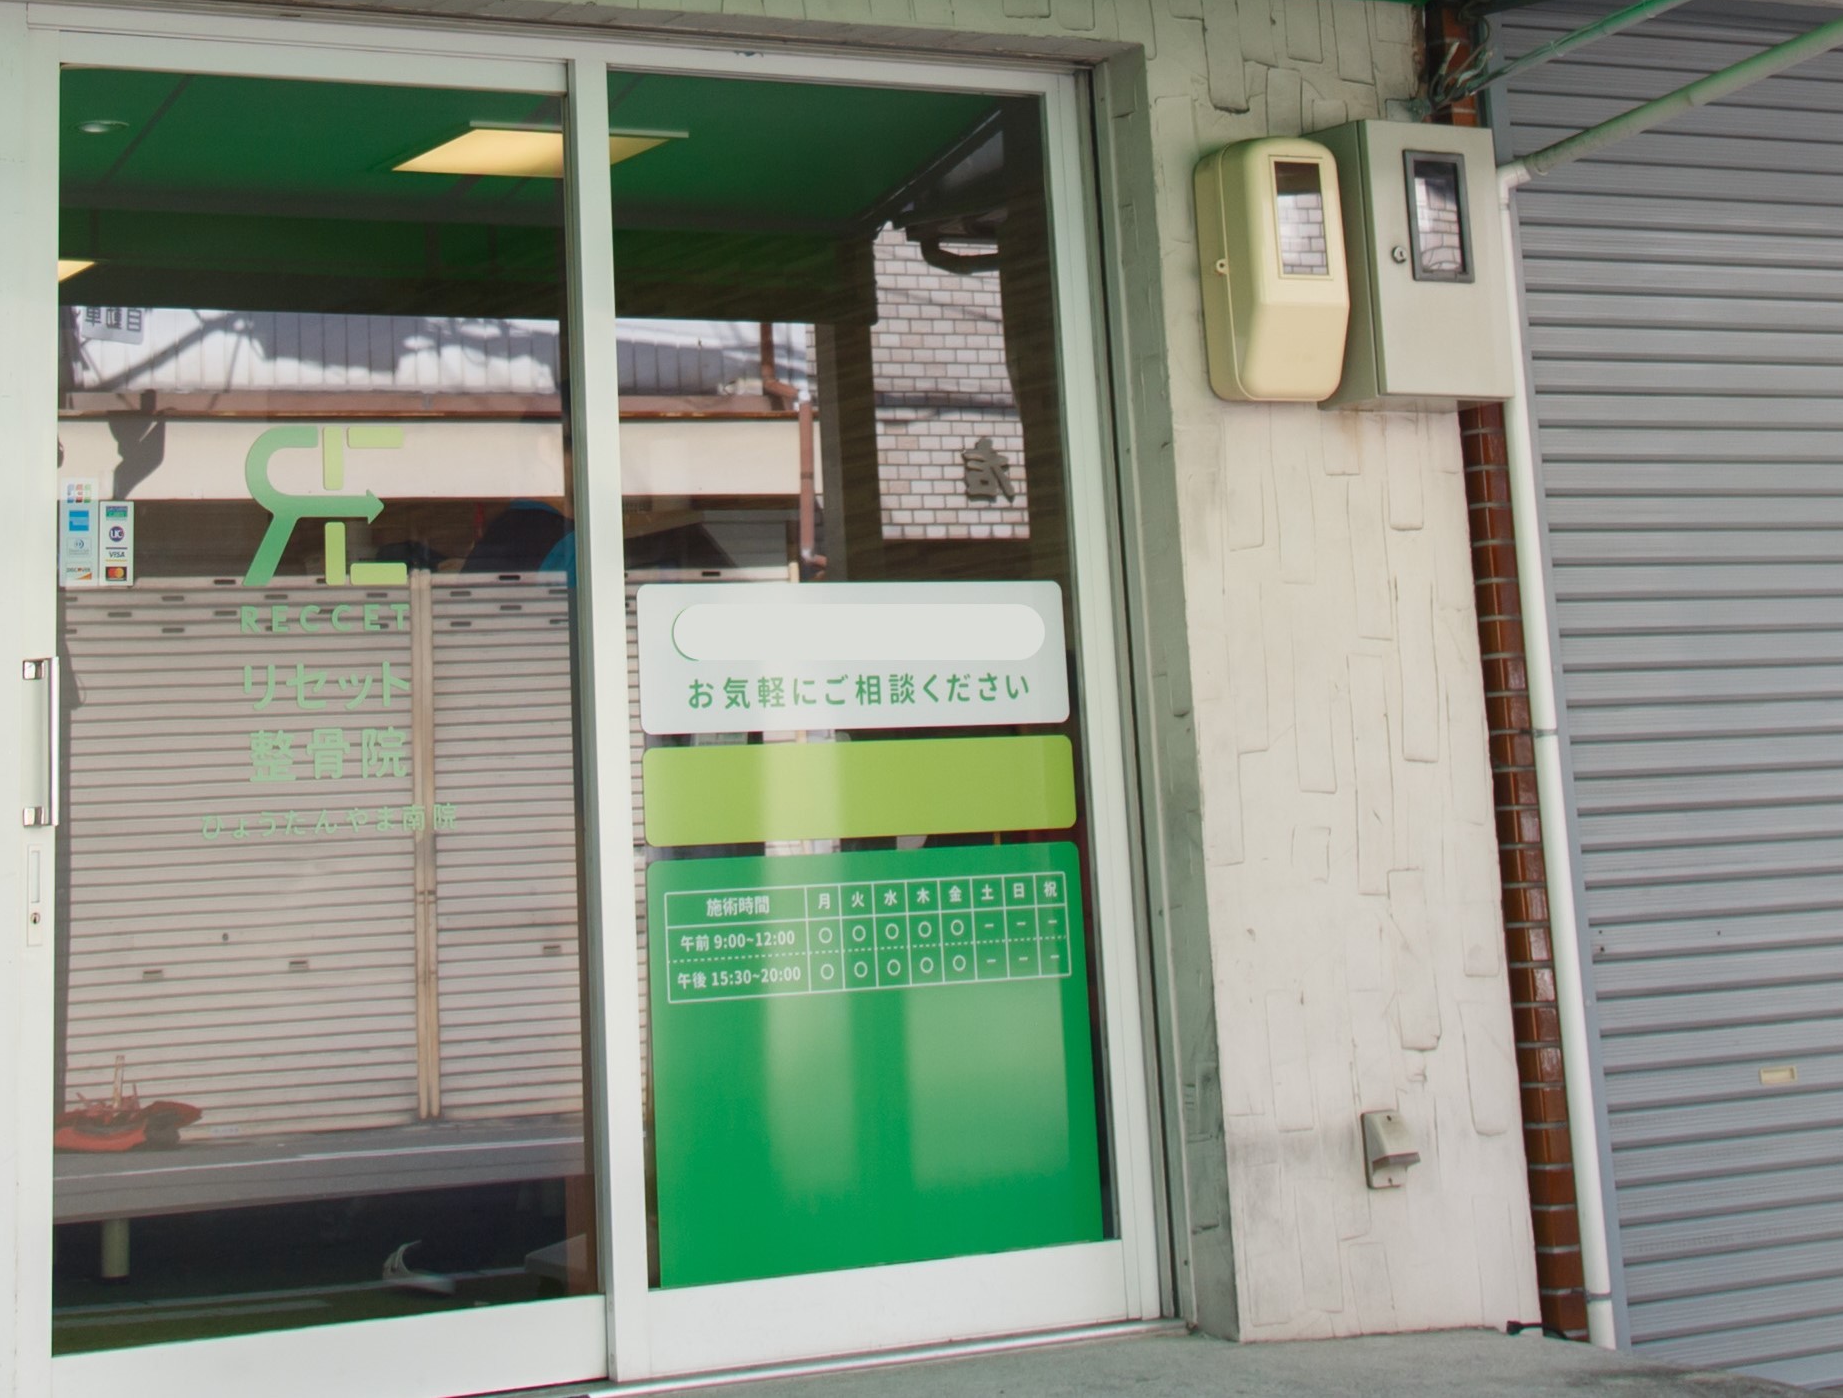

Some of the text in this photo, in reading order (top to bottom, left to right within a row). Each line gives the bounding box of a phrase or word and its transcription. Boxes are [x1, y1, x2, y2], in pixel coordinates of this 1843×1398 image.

[241, 604, 409, 633] RECCET
[243, 660, 410, 710] リセット
[688, 672, 1030, 710] お気軽にご相談ください
[249, 726, 408, 782] 整骨院
[201, 802, 458, 841] ひょうたんやま南院
[706, 881, 1059, 918] 施術時間 月 火 水 木 金 土 日 祝
[680, 935, 709, 952] 午前
[677, 972, 707, 989] 午後
